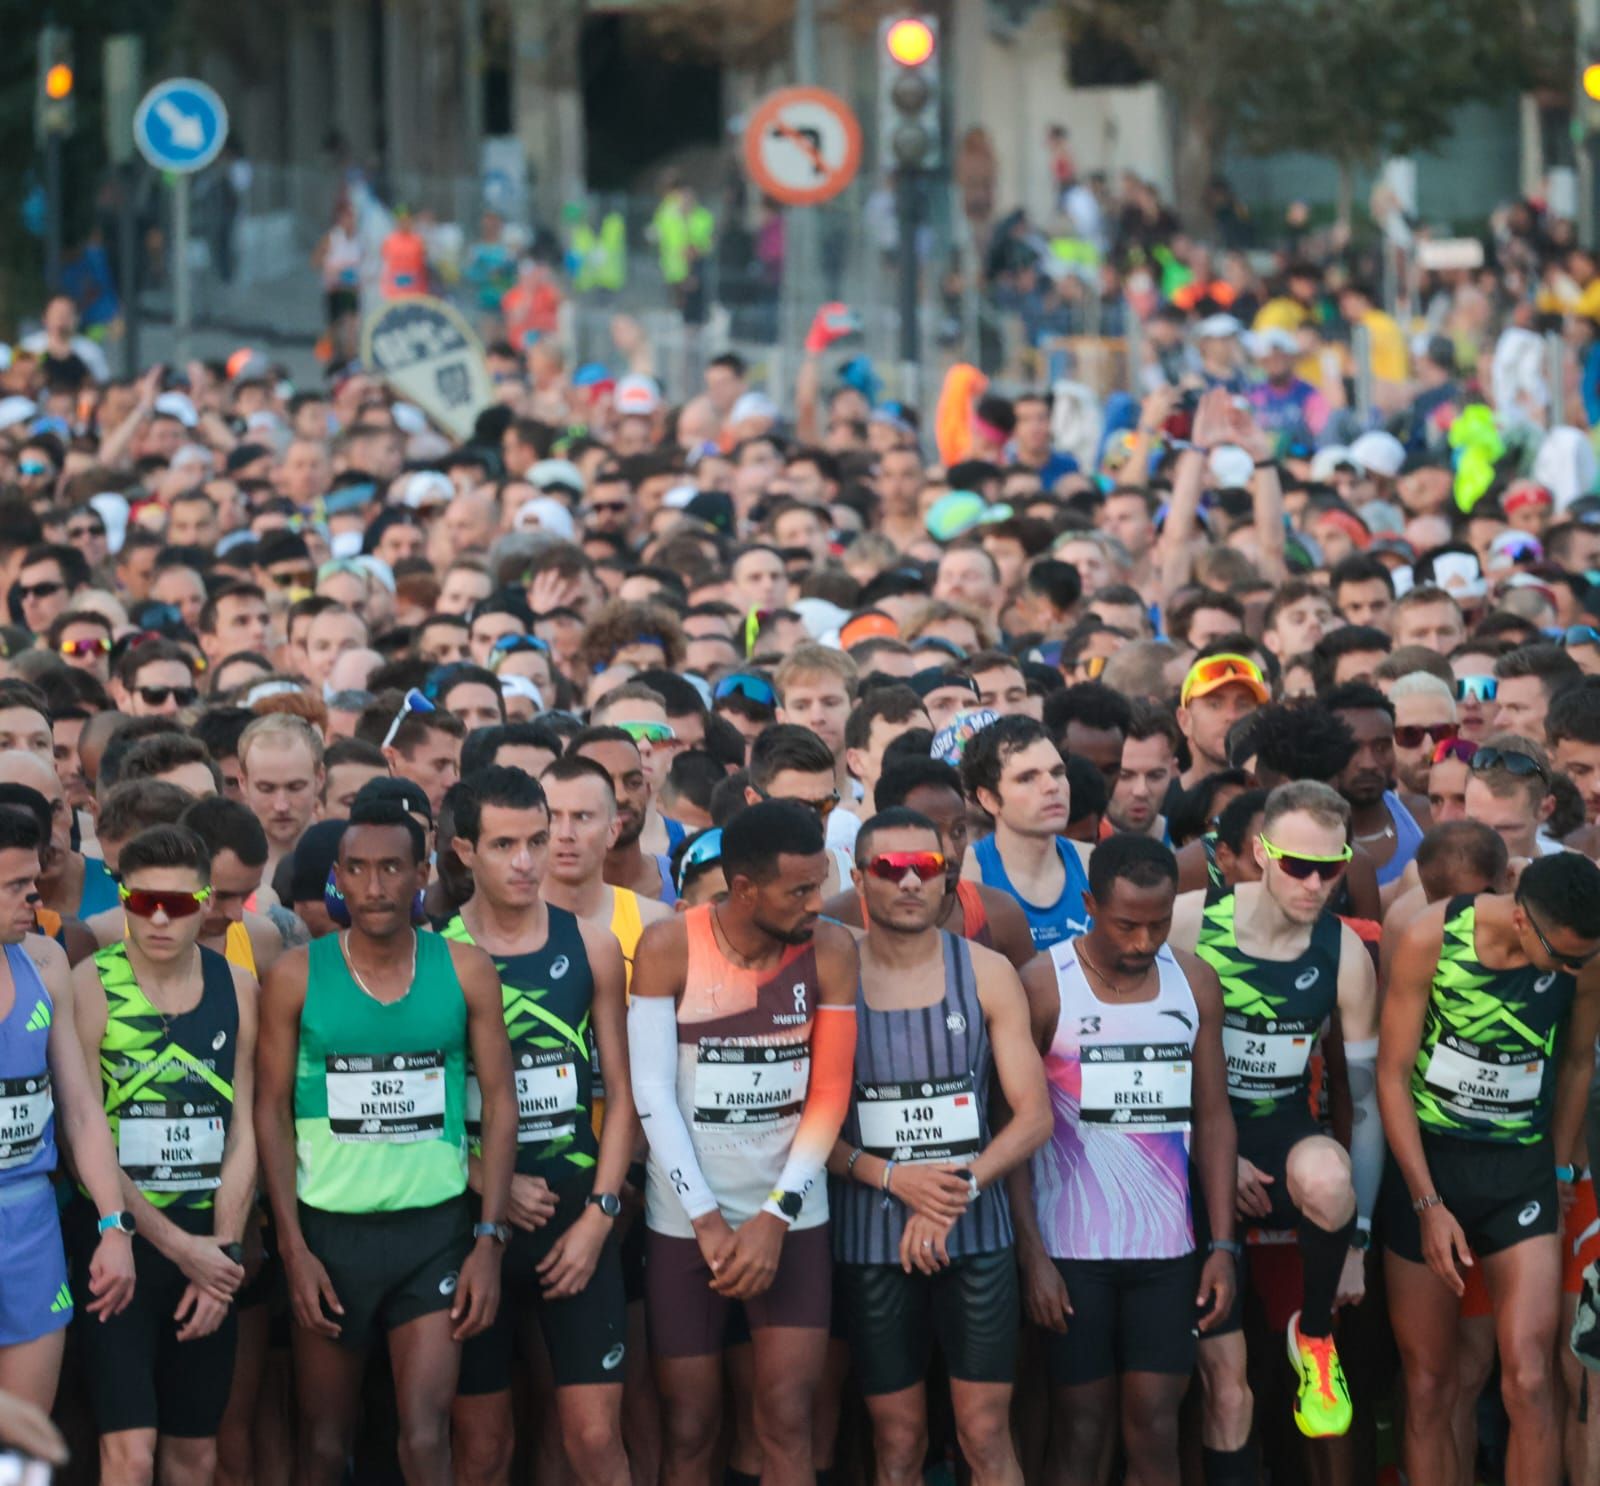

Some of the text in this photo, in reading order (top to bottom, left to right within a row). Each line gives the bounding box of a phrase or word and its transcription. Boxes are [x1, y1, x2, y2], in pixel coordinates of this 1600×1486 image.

[1245, 1040, 1266, 1056] 24
[535, 1052, 563, 1065] ZURICH
[1227, 1055, 1277, 1074] RINGER
[752, 1071, 762, 1087] 7
[1133, 1069, 1144, 1087] 2
[1477, 1067, 1499, 1083] 22
[371, 1080, 404, 1097] 362
[935, 1081, 964, 1094] ZURICH
[1458, 1080, 1510, 1100] CHAKIR
[714, 1088, 793, 1105] T ABRAHAM
[1113, 1090, 1164, 1106] BEKELE
[10, 1103, 29, 1120] 15
[360, 1100, 416, 1116] DEMISO
[902, 1107, 934, 1124] 140
[0, 1122, 35, 1140] MAYO
[165, 1125, 191, 1142] 154
[895, 1126, 943, 1143] RAZYN
